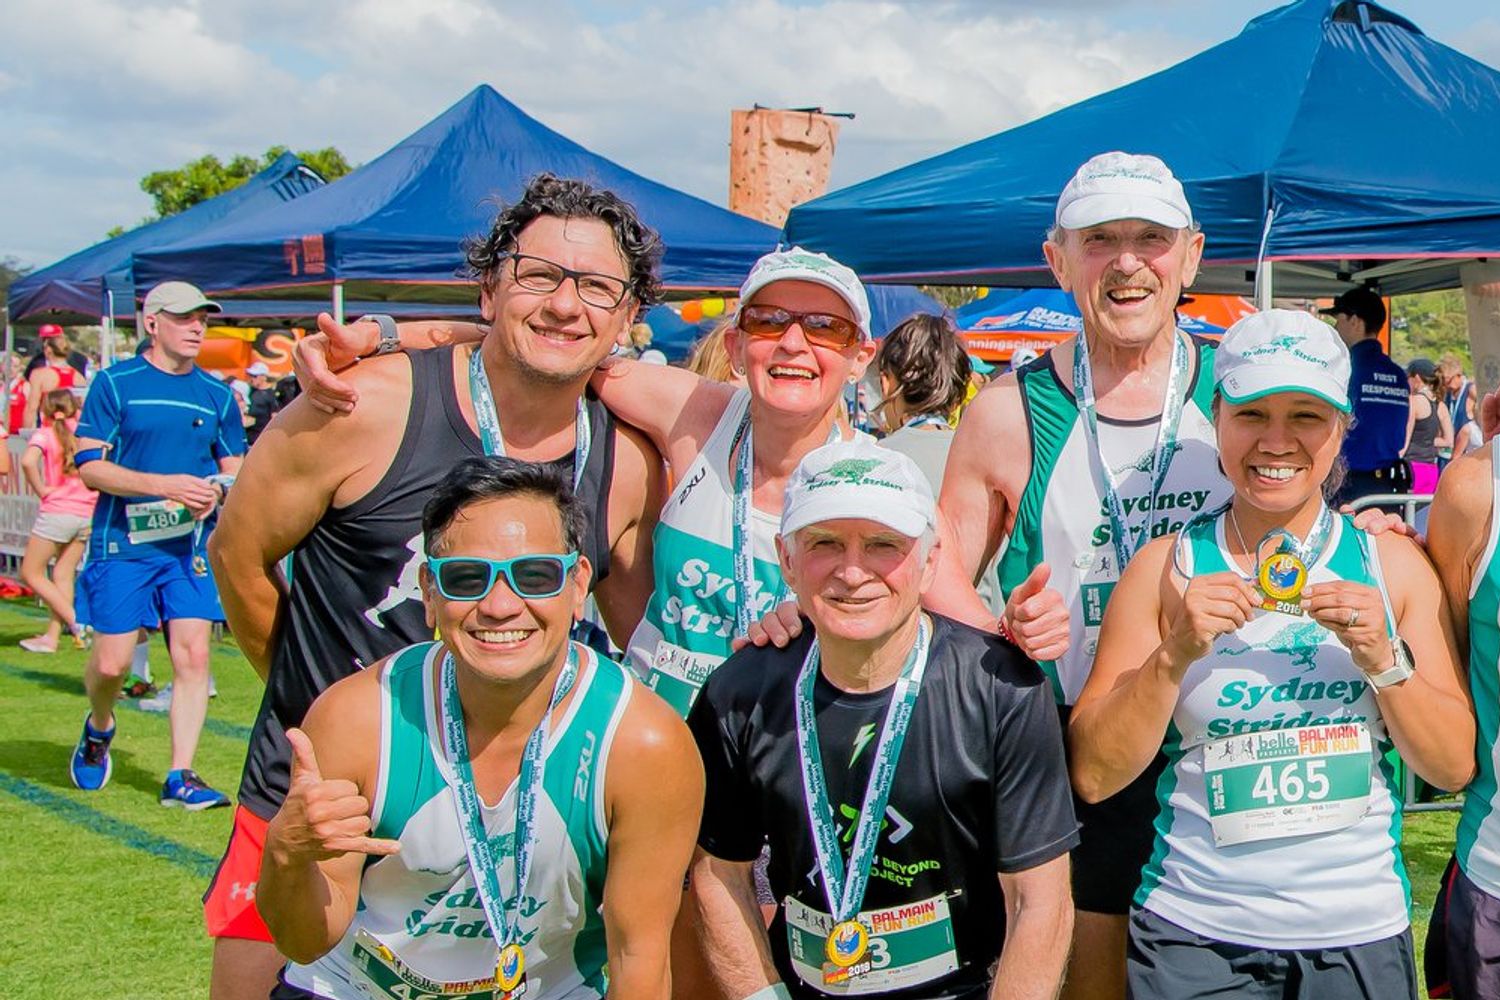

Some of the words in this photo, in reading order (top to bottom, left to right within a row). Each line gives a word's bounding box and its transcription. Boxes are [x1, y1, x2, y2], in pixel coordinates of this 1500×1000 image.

[967, 338, 1057, 351] nningscience
[1361, 384, 1409, 398] RESPONDE
[679, 466, 707, 505] 2XU
[147, 512, 179, 529] 480
[1217, 676, 1369, 711] Sydney
[1258, 732, 1296, 749] belle
[1299, 726, 1359, 743] BALMAIN
[1299, 740, 1328, 756] FUN
[1333, 738, 1360, 752] RUN
[573, 730, 597, 802] 2XU
[1251, 759, 1331, 805] 465
[882, 856, 942, 875] BEYOND
[871, 902, 936, 924] BALMAIN
[874, 919, 903, 933] FUN
[907, 911, 936, 927] RUN
